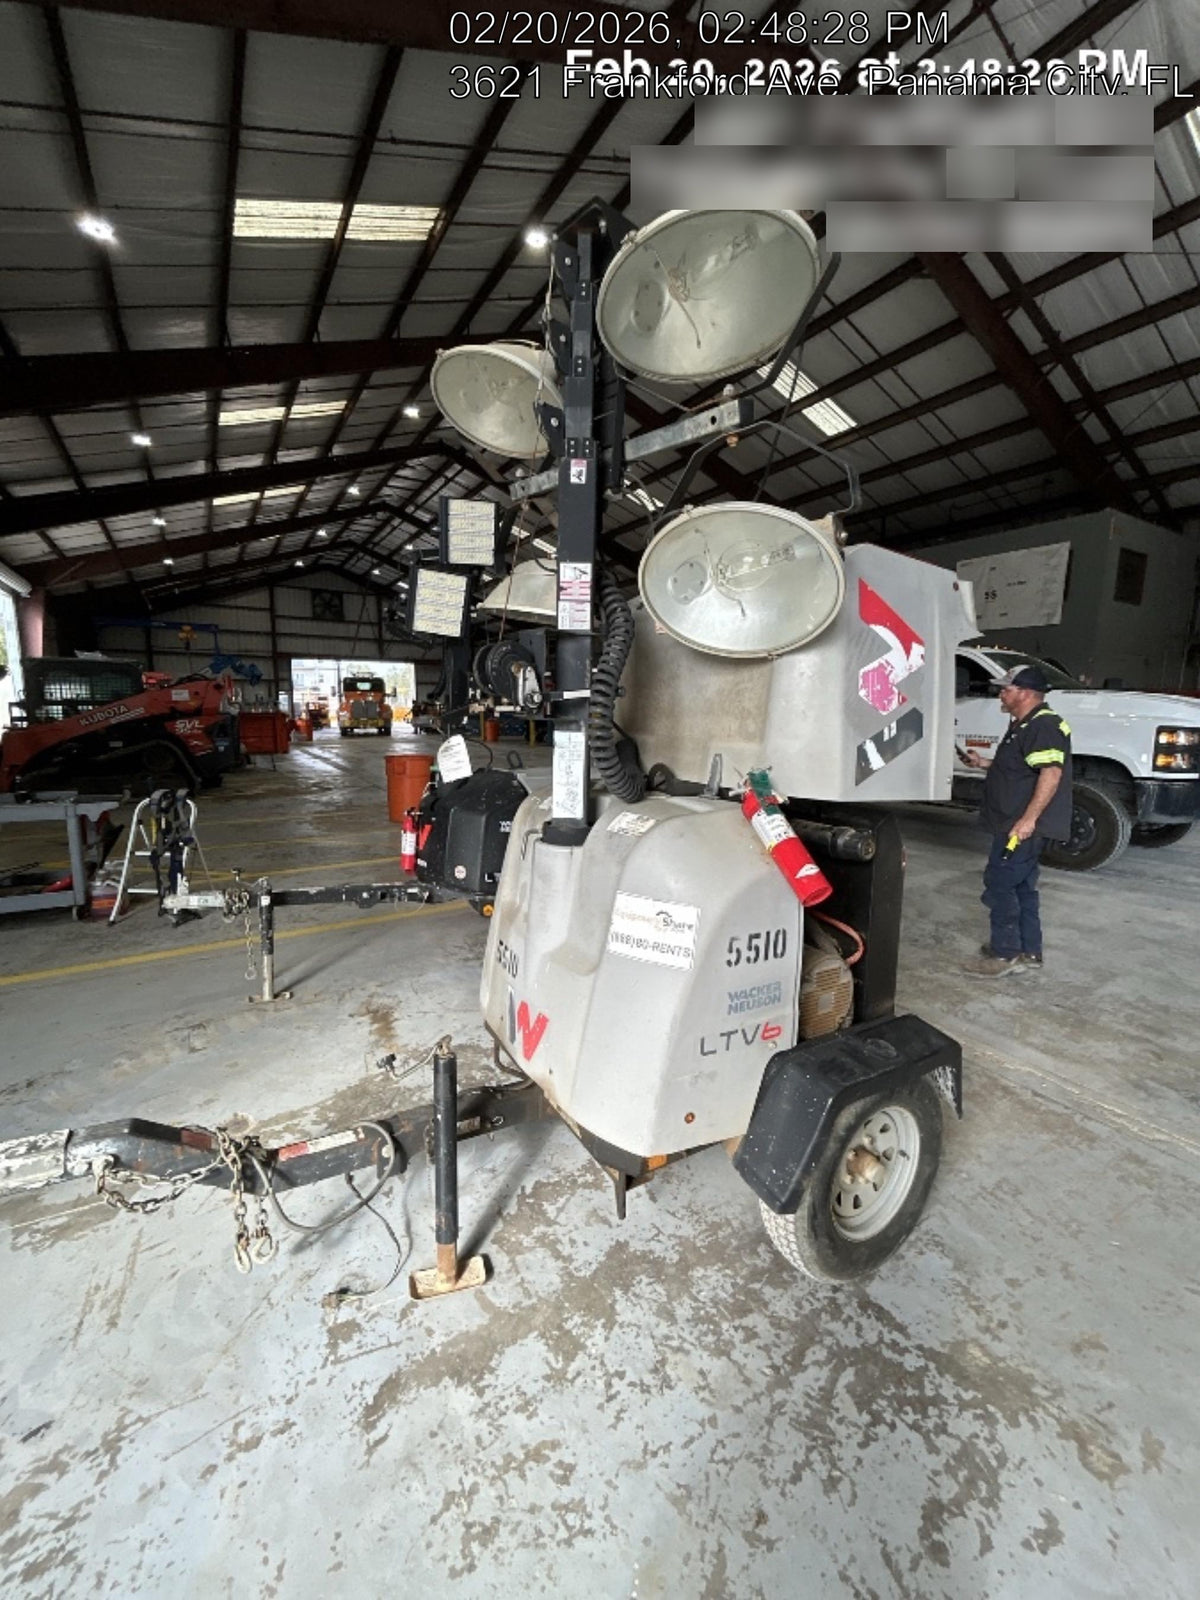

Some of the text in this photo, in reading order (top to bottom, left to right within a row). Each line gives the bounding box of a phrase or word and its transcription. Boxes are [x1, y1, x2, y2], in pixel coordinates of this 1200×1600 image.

[79, 705, 130, 727] KUBOTA
[726, 927, 787, 968] 5510
[727, 980, 782, 1003] WACKER
[727, 994, 782, 1016] NEUSON
[699, 1021, 783, 1057] LTV6
